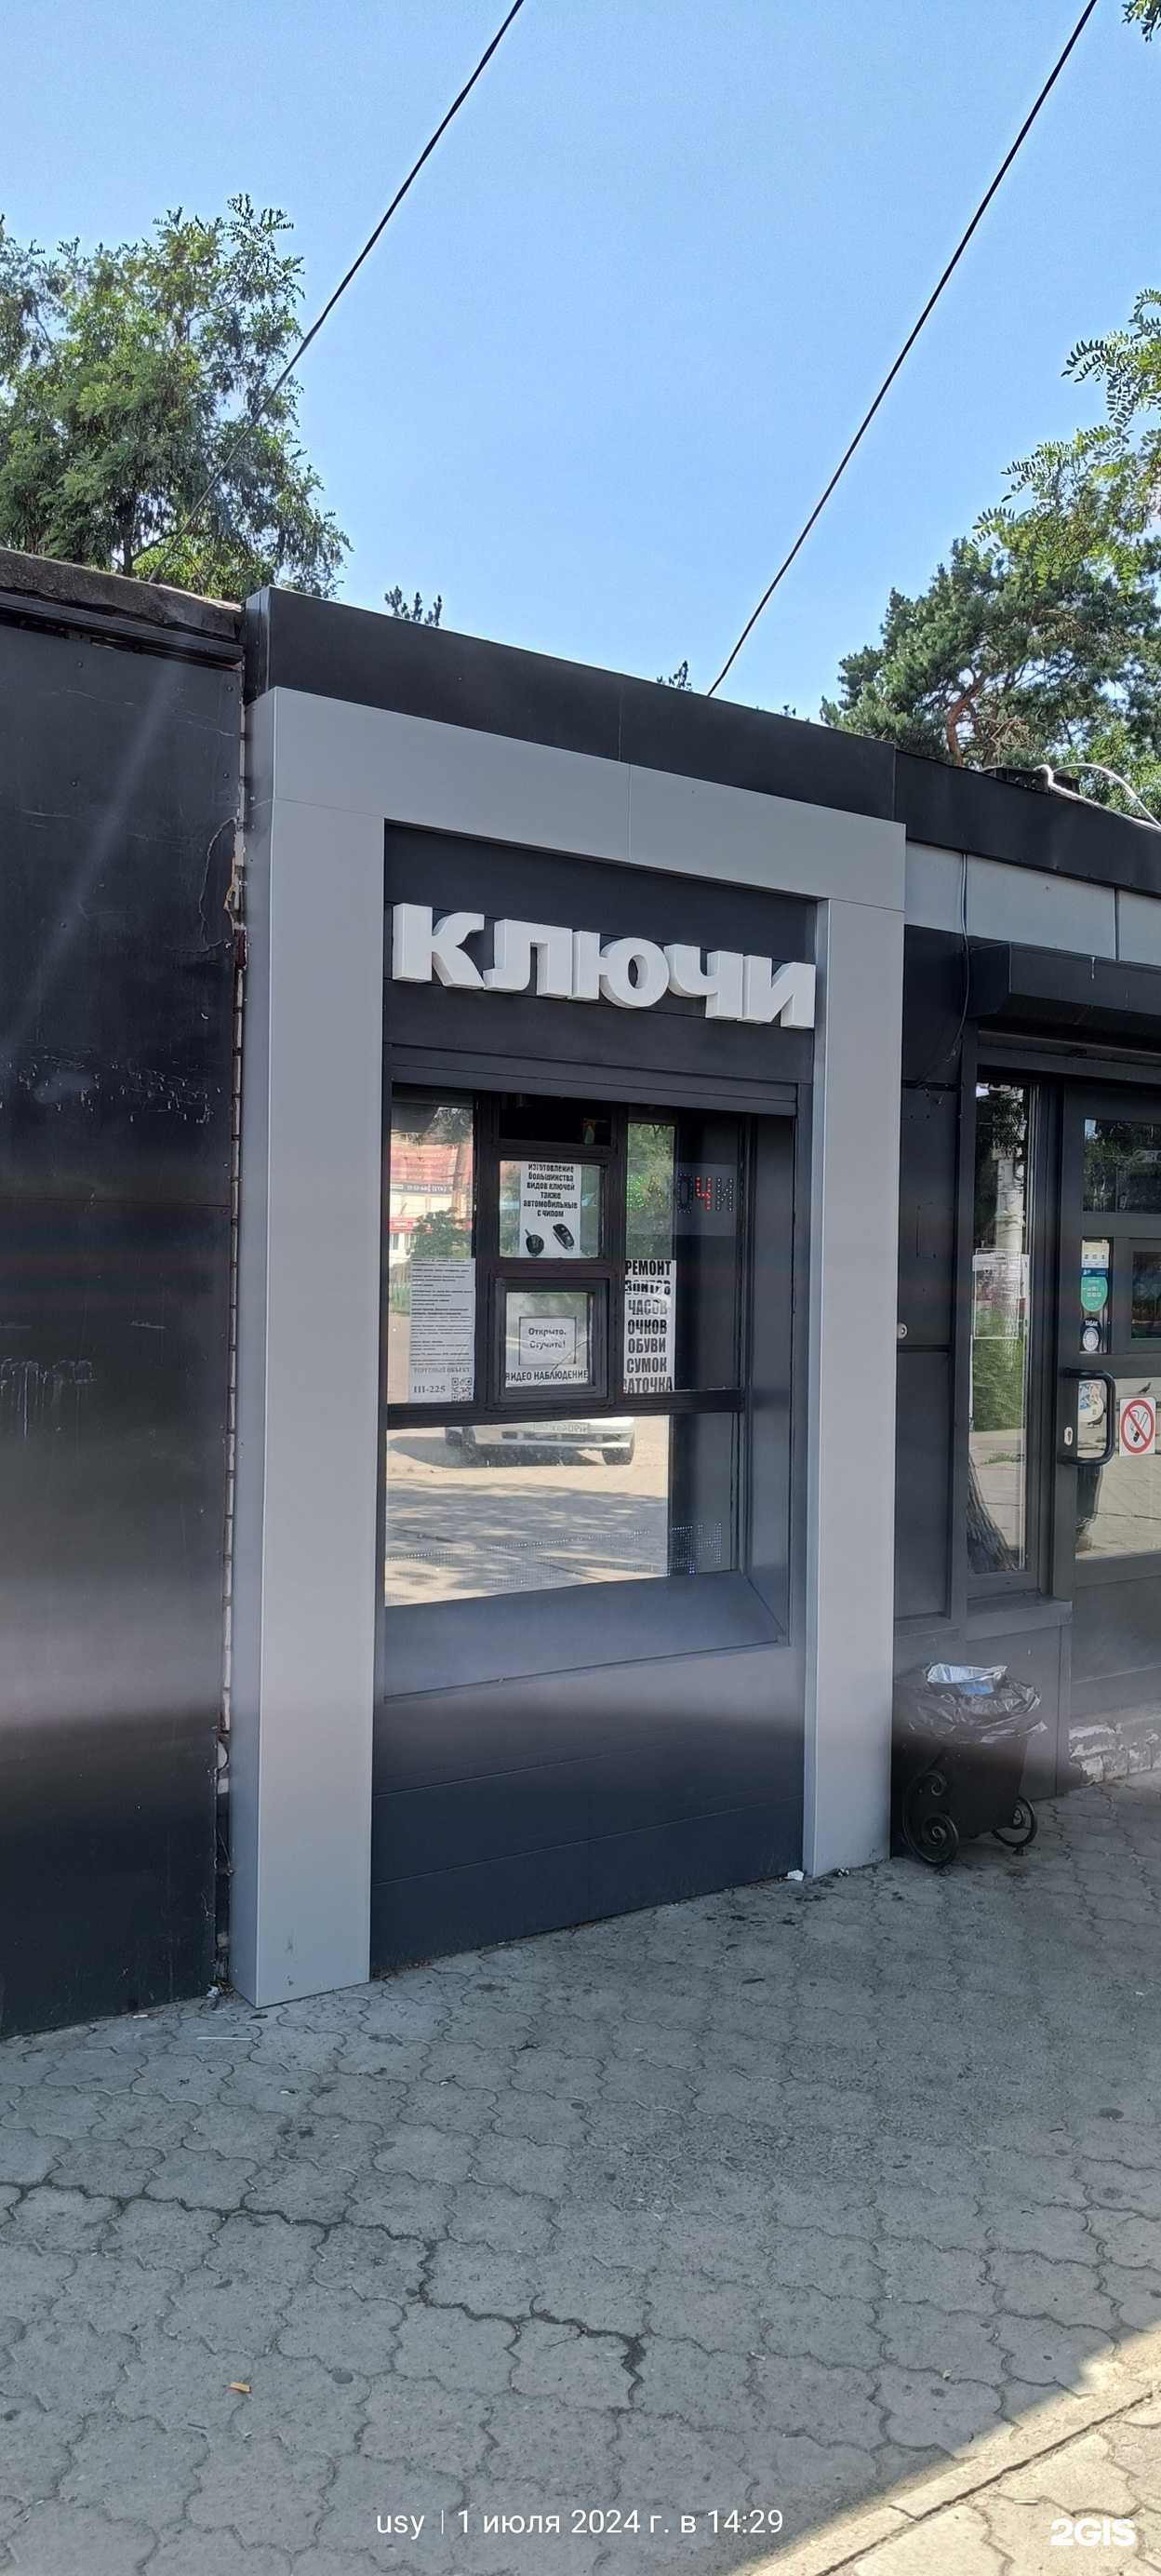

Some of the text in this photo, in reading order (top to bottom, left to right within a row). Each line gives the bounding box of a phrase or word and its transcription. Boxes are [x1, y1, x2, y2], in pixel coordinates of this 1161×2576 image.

[393, 903, 816, 1029] КЛЮЧИ
[625, 1259, 672, 1276] РЕМОНТ
[628, 1299, 668, 1316] ЧАСОВ
[627, 1319, 667, 1335] ОЧКОВ
[628, 1337, 666, 1354] ОБУВИ
[626, 1357, 667, 1374] СУМОК
[533, 1369, 588, 1380] НАБЛЮДЕНИЕ
